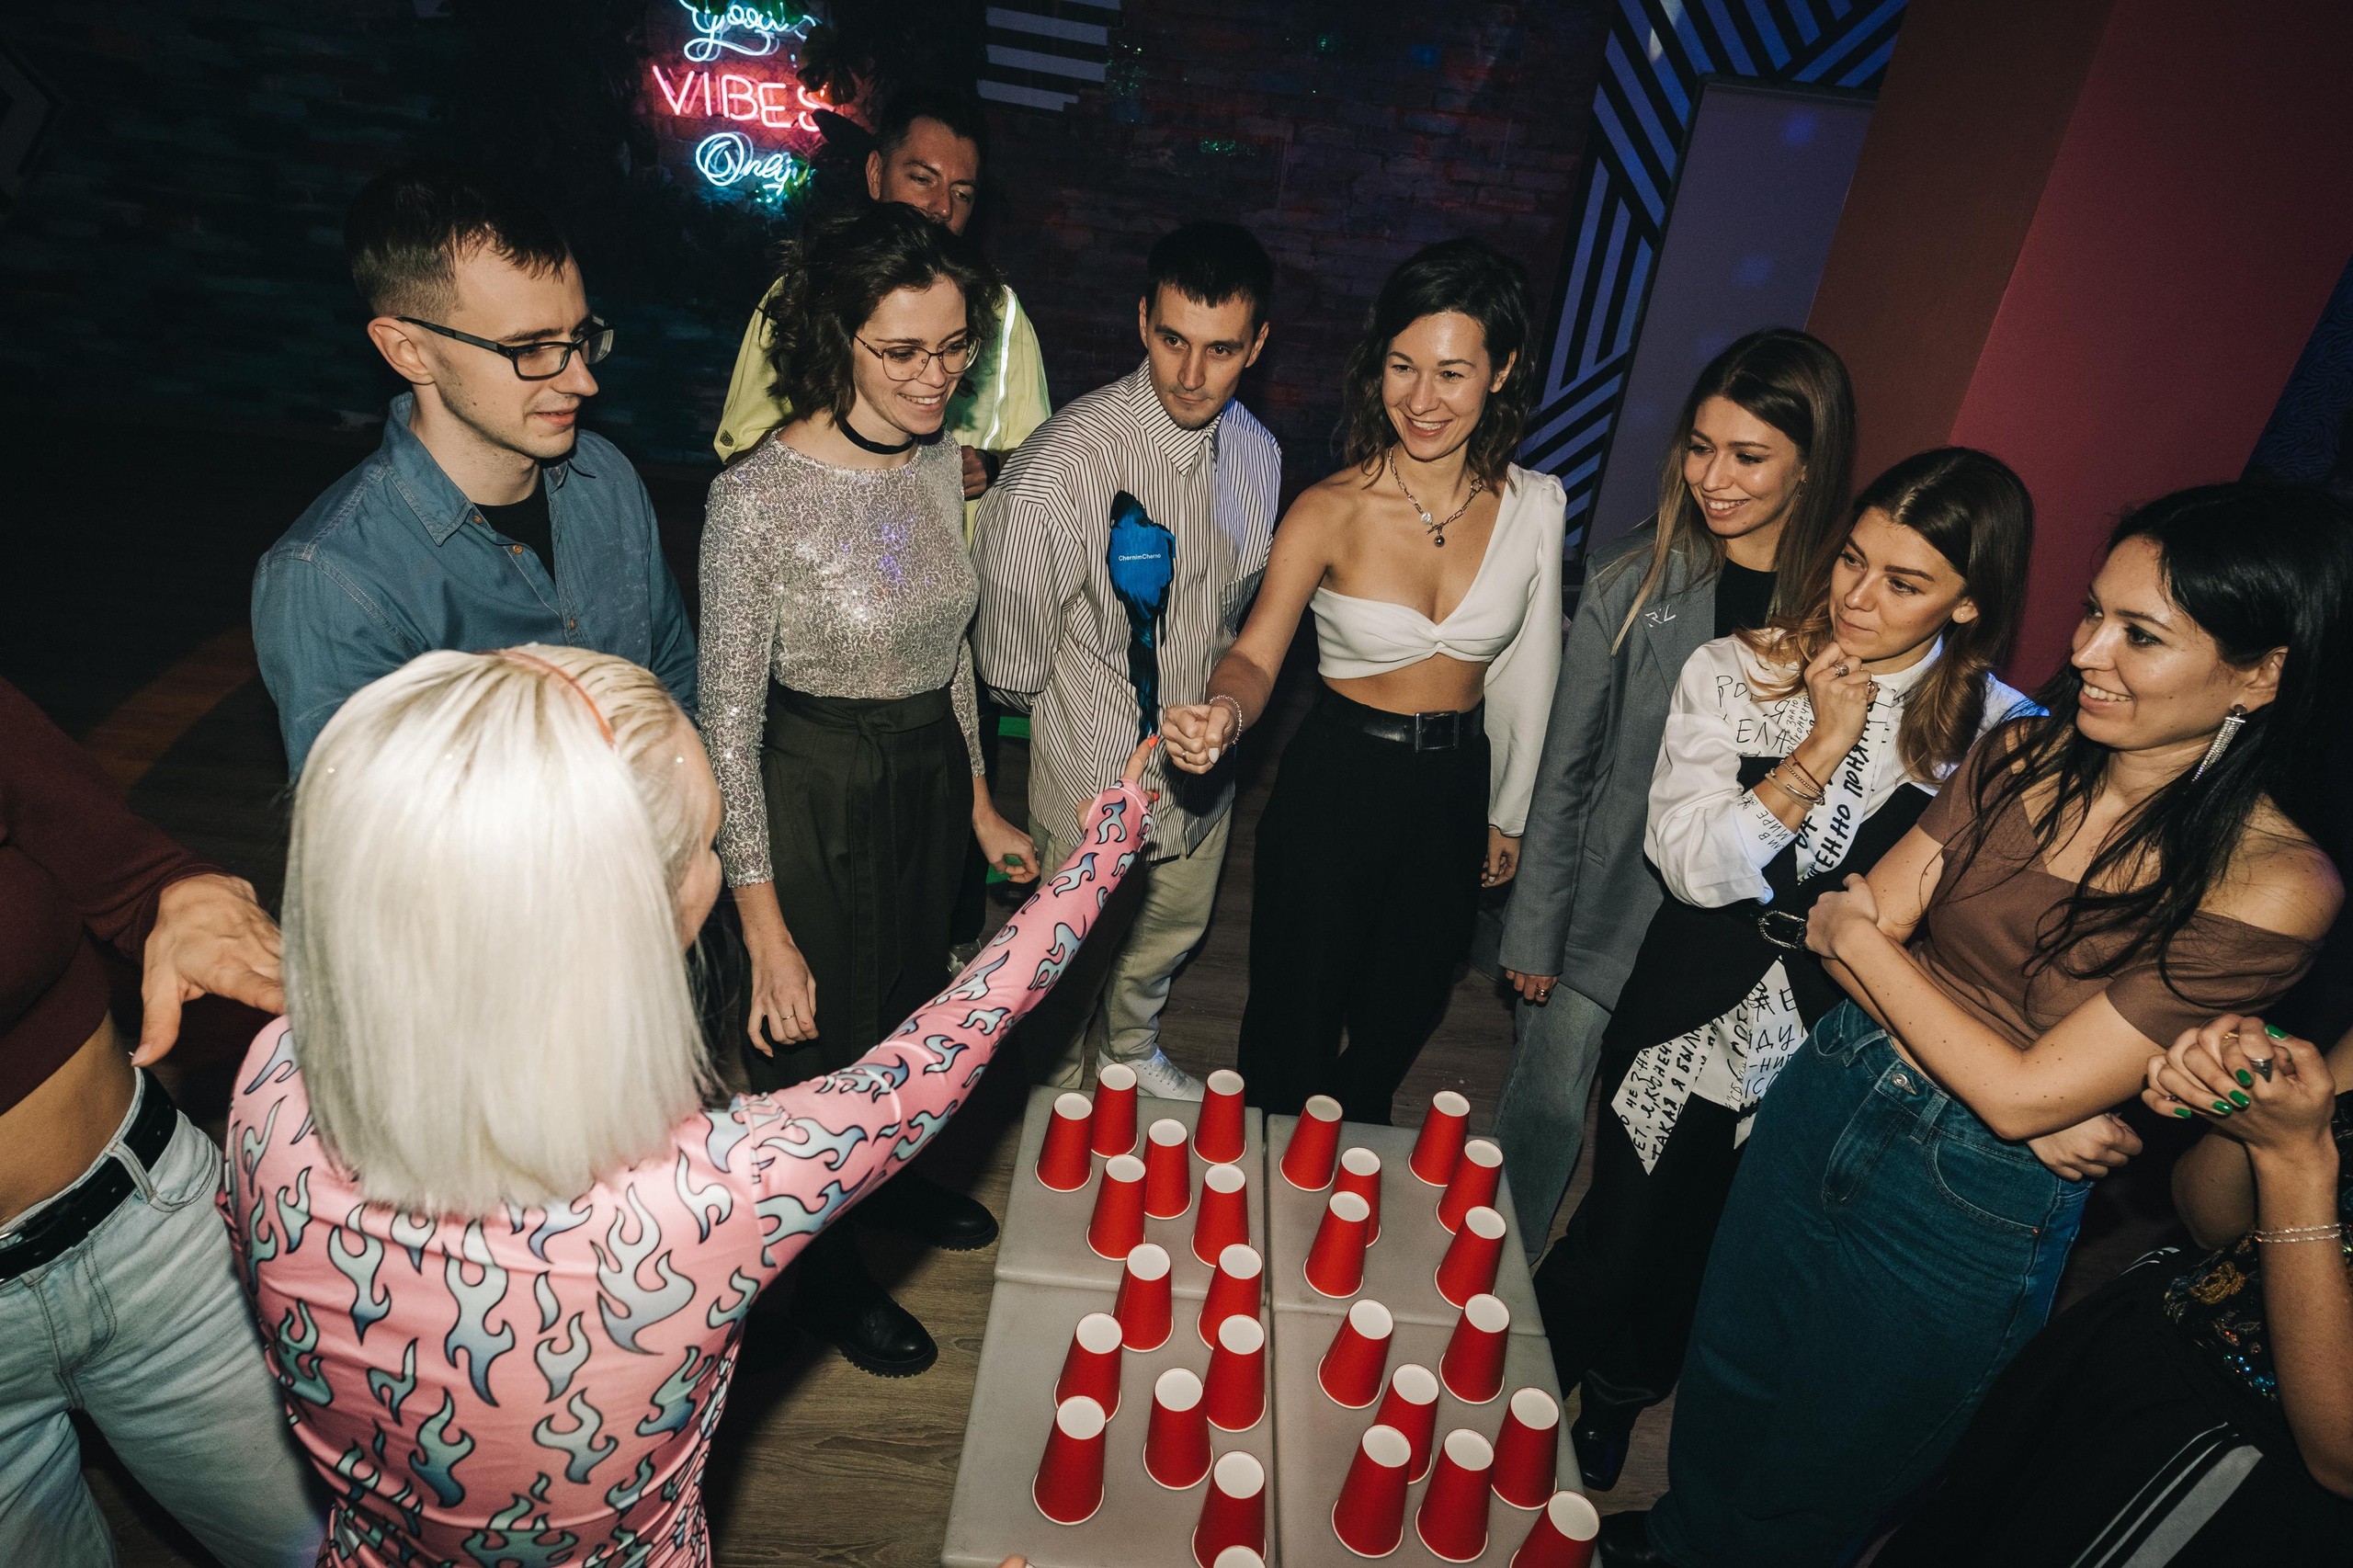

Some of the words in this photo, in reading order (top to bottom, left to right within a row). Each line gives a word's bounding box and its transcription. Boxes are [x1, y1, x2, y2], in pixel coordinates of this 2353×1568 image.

[652, 64, 835, 132] VIBES
[695, 131, 793, 197] Only
[1631, 1047, 1655, 1090] ЗНА
[1644, 1041, 1673, 1101] КОНЕЧ
[1670, 1077, 1687, 1093] Я
[1625, 1088, 1639, 1109] НЕ
